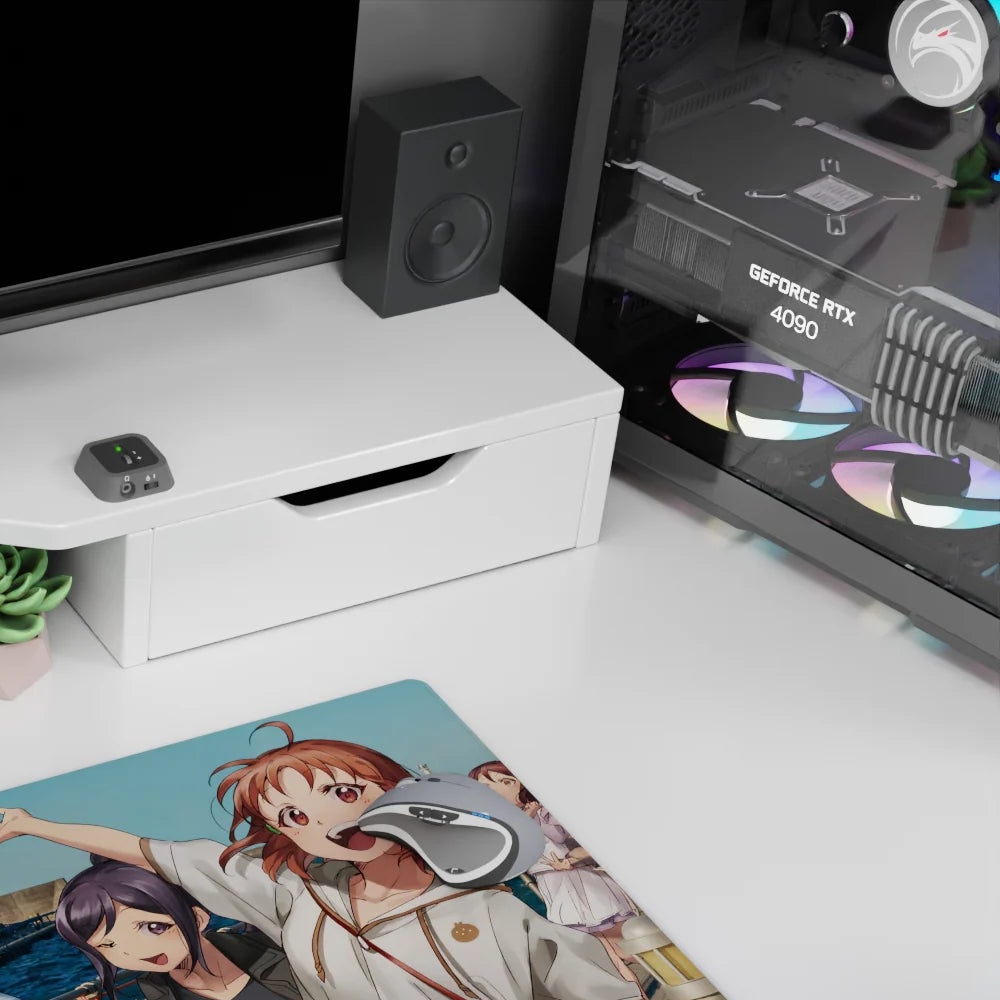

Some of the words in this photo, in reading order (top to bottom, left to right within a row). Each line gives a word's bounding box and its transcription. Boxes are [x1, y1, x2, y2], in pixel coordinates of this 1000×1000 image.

[748, 263, 821, 310] GEFORCE
[821, 297, 857, 327] RTX
[769, 305, 819, 340] 4090
